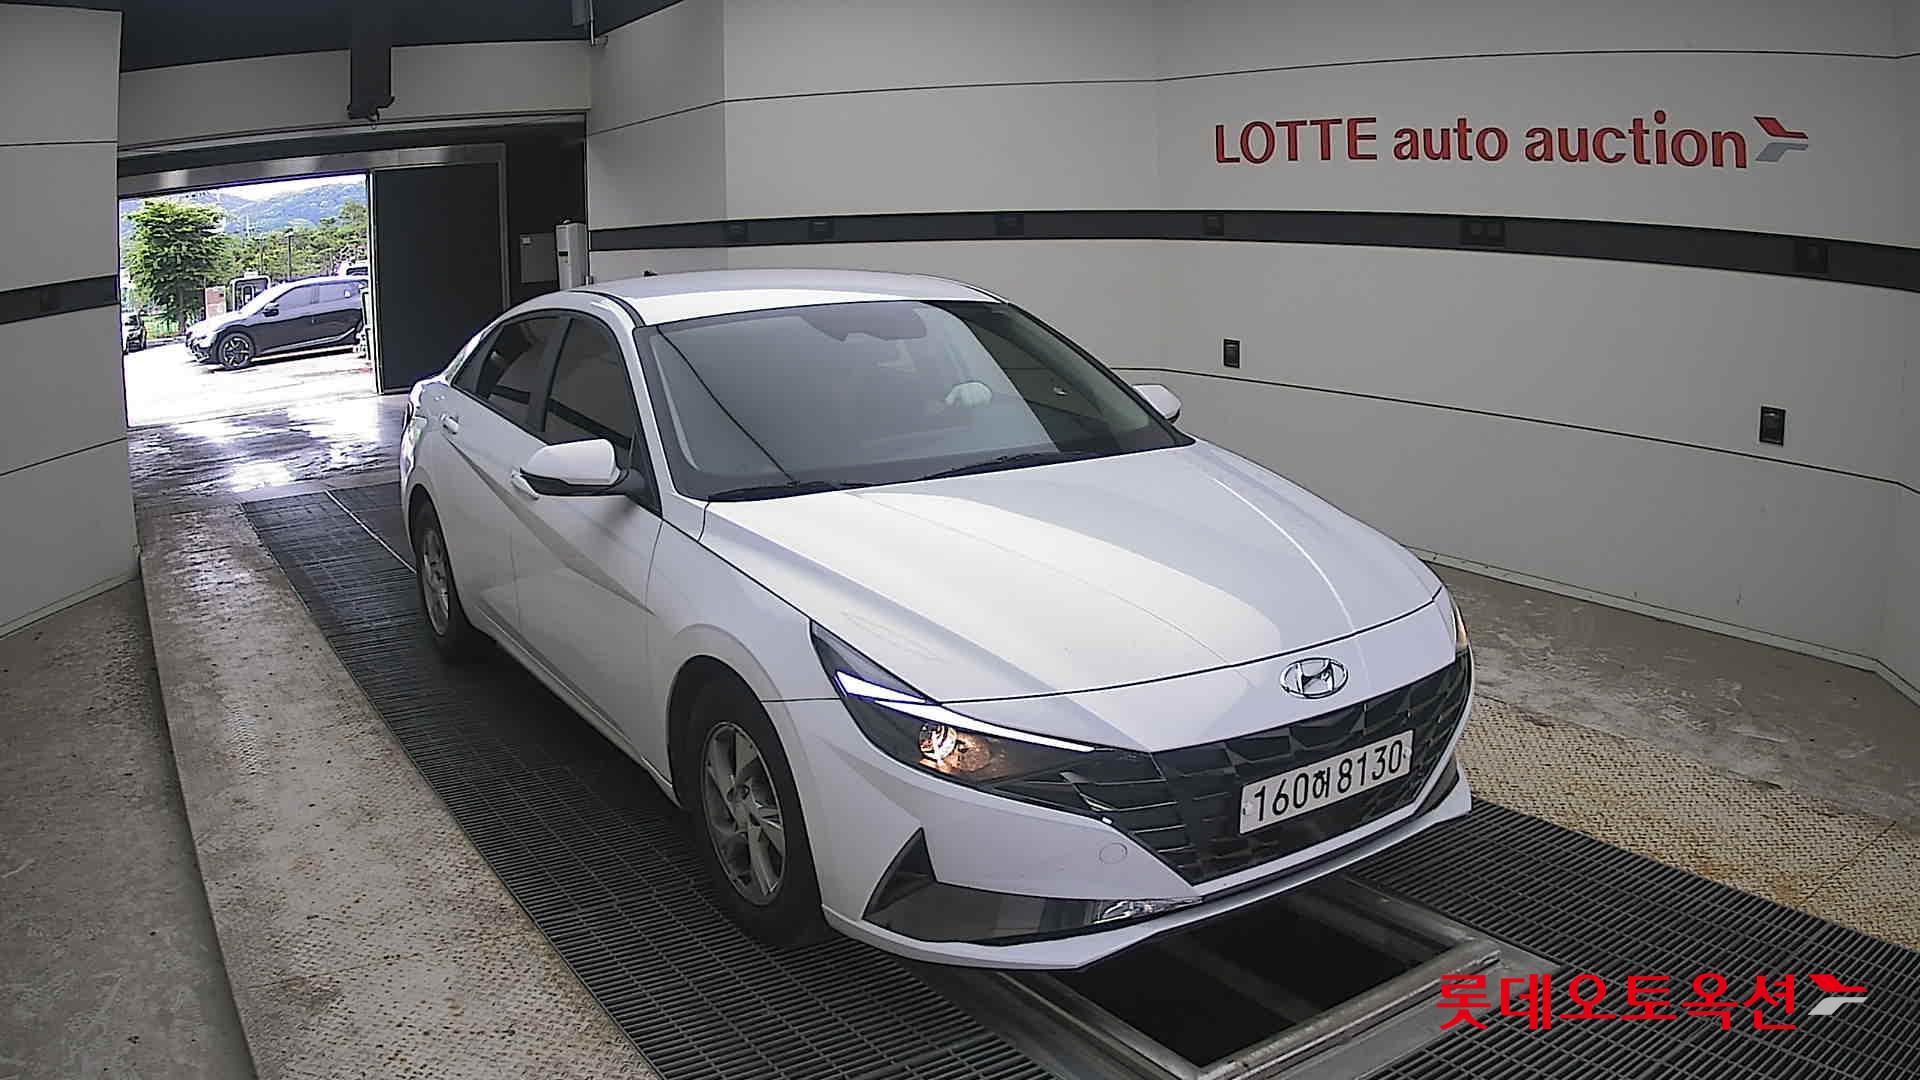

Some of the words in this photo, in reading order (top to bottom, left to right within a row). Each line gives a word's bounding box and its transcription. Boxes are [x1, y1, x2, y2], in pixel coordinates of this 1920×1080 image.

[1214, 117, 1377, 164] LOTTE
[1393, 117, 1509, 162] auto
[1524, 109, 1748, 169] auction
